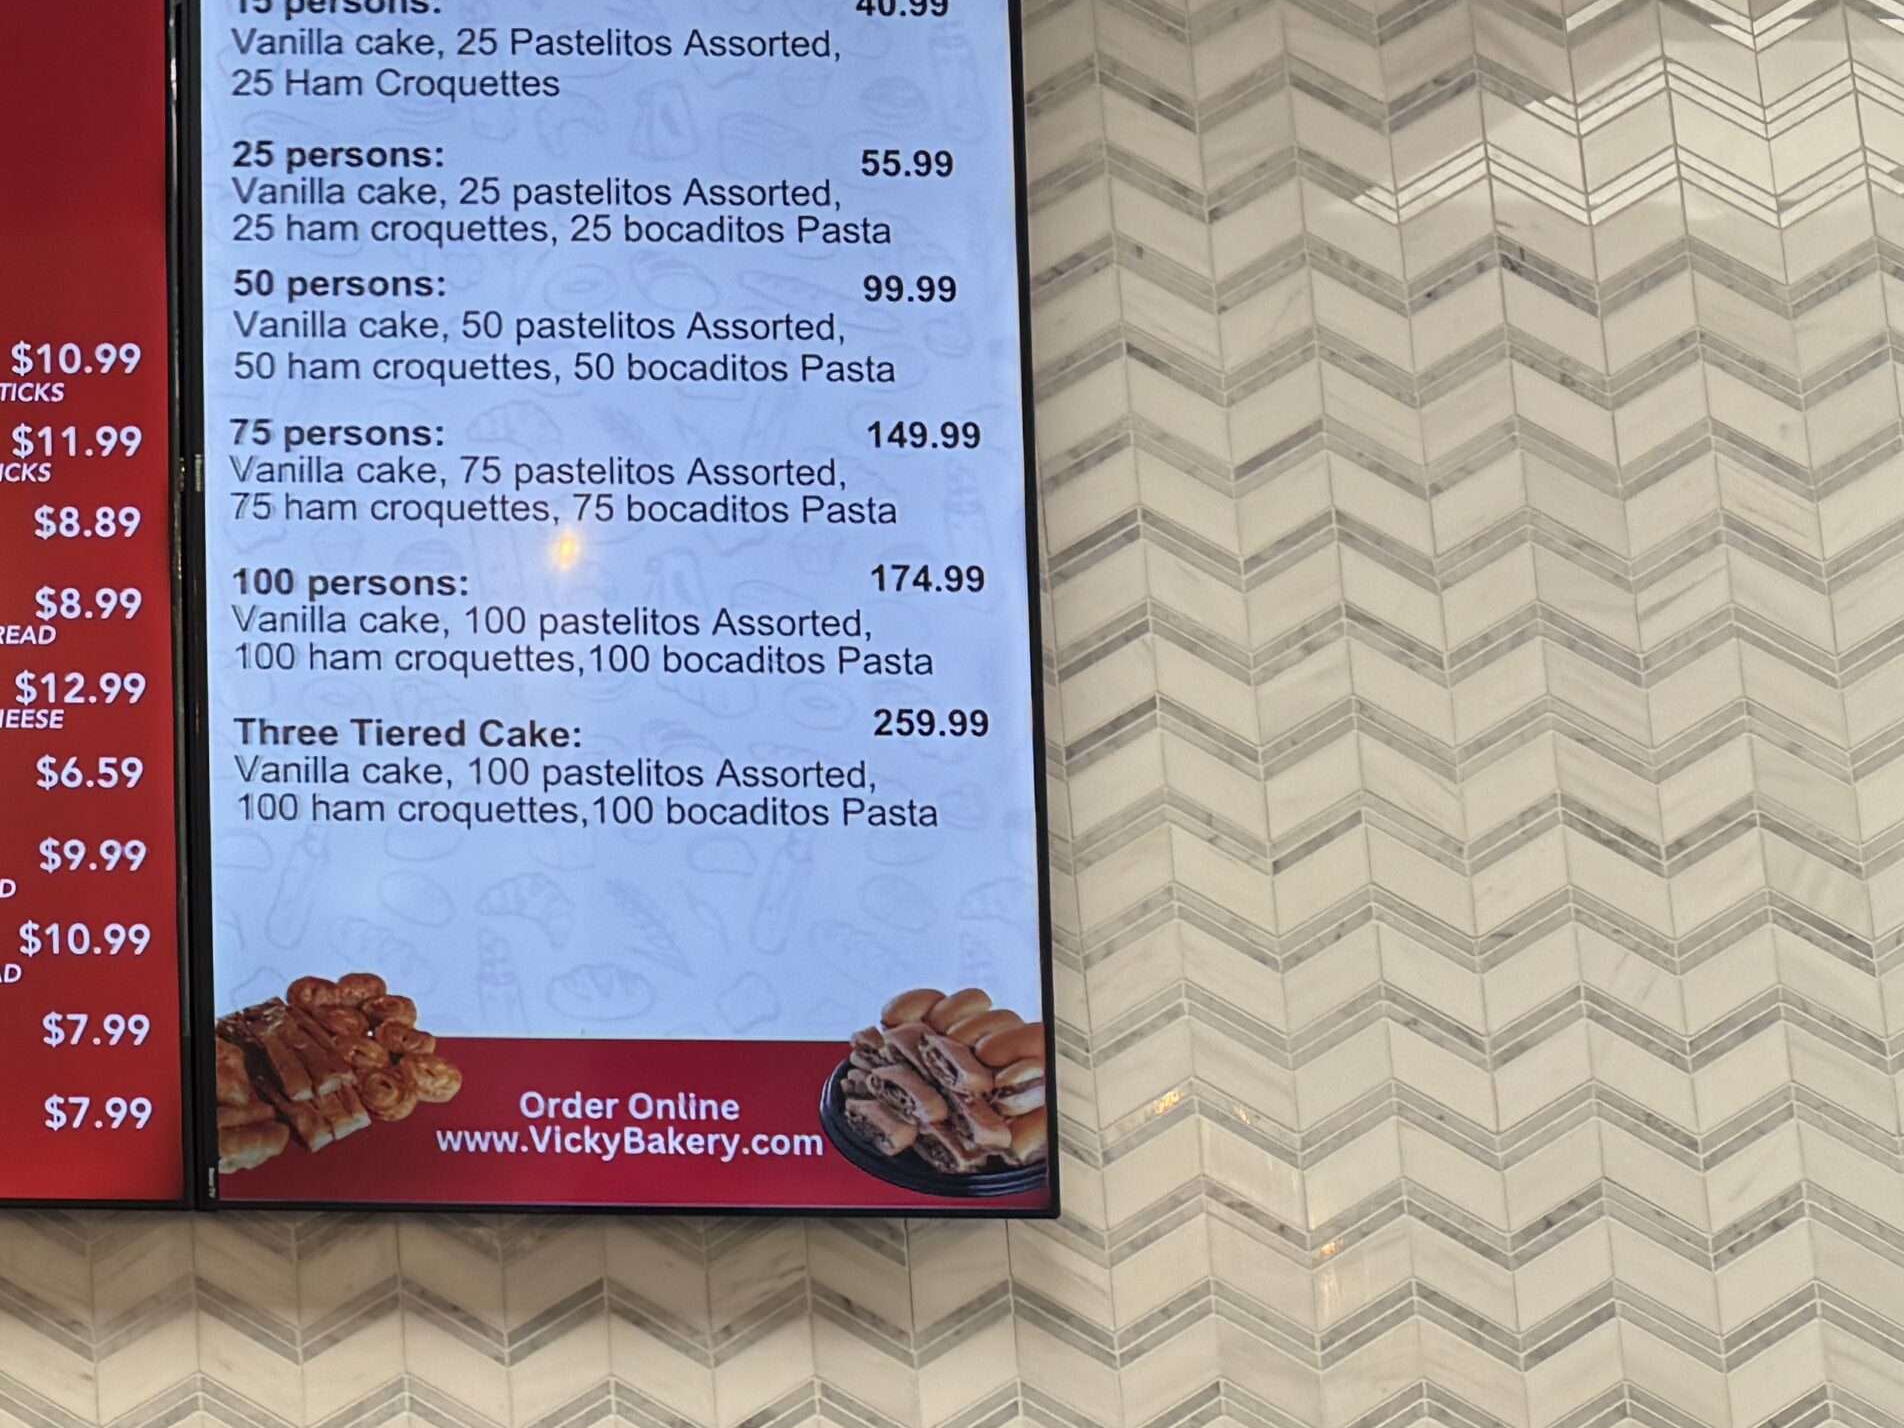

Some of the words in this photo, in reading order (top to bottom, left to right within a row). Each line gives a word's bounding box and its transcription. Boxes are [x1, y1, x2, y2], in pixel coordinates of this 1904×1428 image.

[231, 28, 344, 55] Vanilla
[356, 28, 443, 59] cake,
[457, 28, 497, 55] 25
[511, 28, 672, 56] Pastelitos
[684, 29, 840, 61] Assorted,
[232, 69, 273, 96] 25
[286, 69, 362, 96] Ham
[376, 68, 560, 103] Croquettes
[12, 341, 140, 376] $10.99
[35, 505, 140, 540] $8.89
[233, 568, 294, 595] 100
[309, 575, 467, 602] persons:
[871, 564, 984, 592] 174.99
[16, 670, 145, 706] $12.99
[234, 718, 338, 746] Three
[350, 719, 465, 747] Tiered
[480, 719, 580, 747] Cake:
[874, 709, 988, 737] 259.99
[40, 837, 146, 873] $9.99
[20, 920, 150, 957] $10.99
[45, 1094, 152, 1131] $7.99
[520, 1091, 619, 1119] Order
[629, 1092, 739, 1120] Online
[437, 1125, 822, 1162] www.VickyBakery.com
